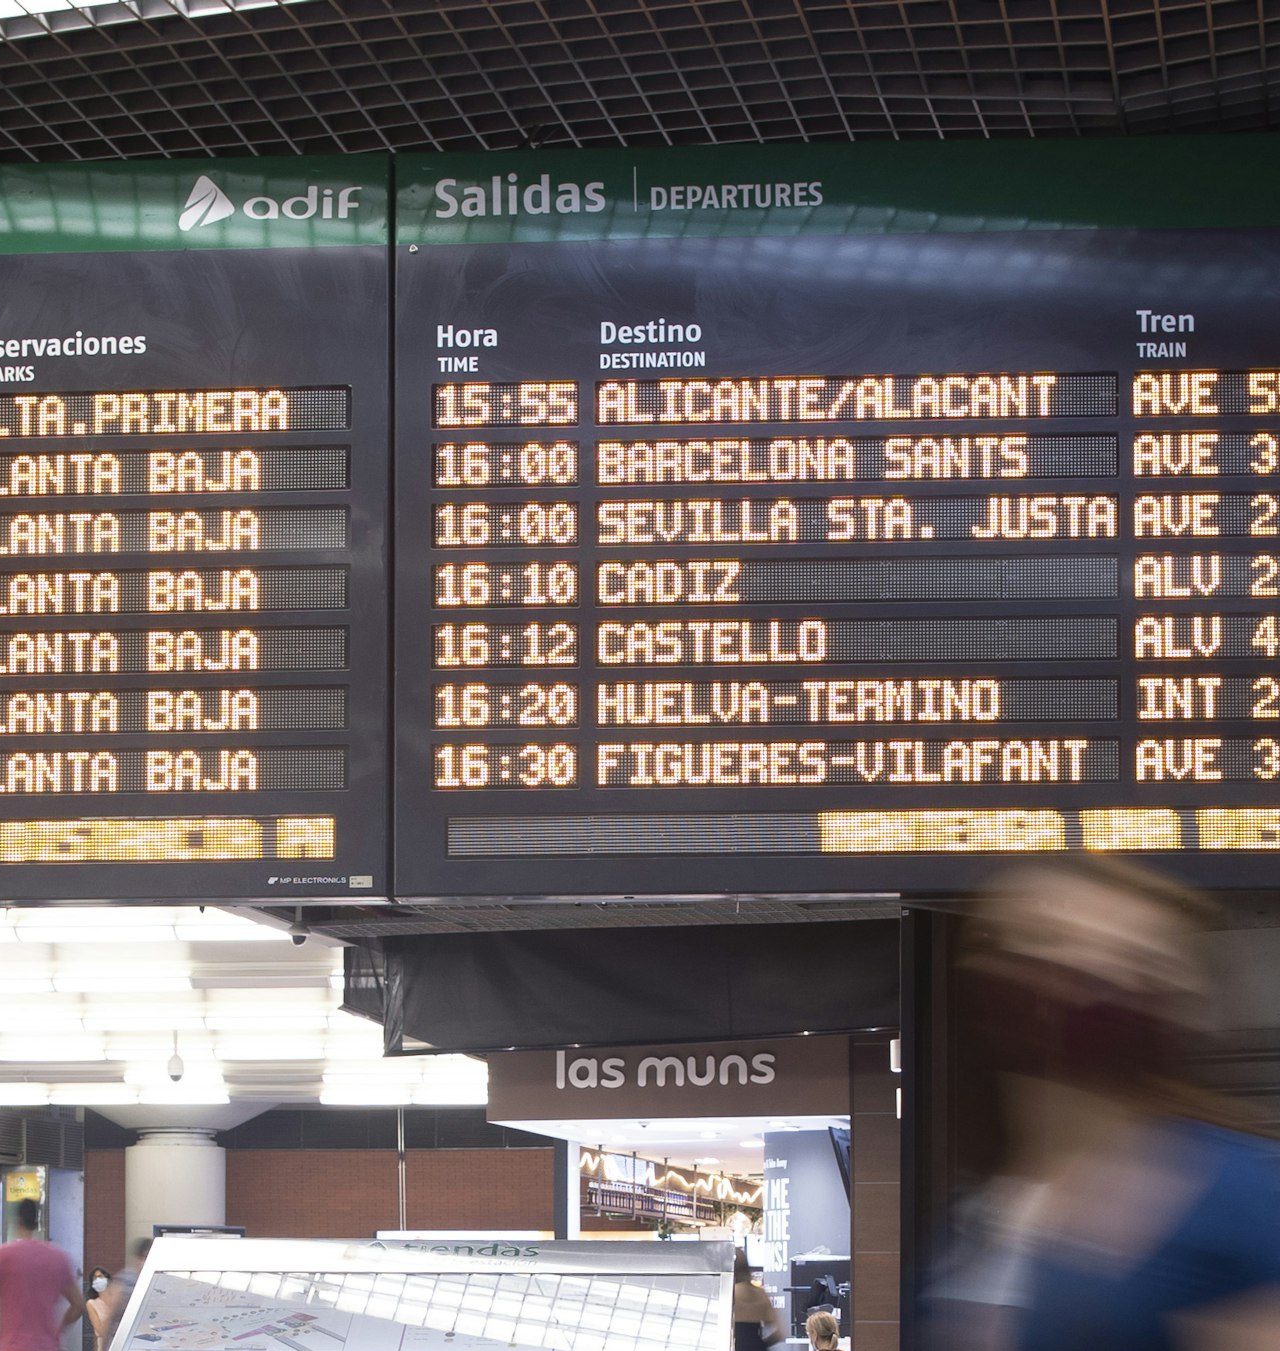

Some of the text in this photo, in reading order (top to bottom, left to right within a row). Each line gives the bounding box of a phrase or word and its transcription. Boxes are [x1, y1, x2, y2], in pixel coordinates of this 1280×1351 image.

[244, 186, 362, 220] adif
[435, 173, 823, 218] Salidas DEPARTURES
[438, 325, 497, 347] Hora
[601, 318, 701, 343] Destino
[1136, 310, 1194, 332] Tren
[438, 357, 478, 372] TIME
[600, 352, 705, 368] DESTINATION
[1137, 343, 1186, 357] TRAIN
[438, 383, 575, 425] 15:55
[598, 375, 1056, 423] ALICANTE/ALACANT
[1133, 373, 1218, 415] AVE
[149, 450, 259, 492] BAJA
[438, 443, 575, 485] 16:00
[598, 439, 854, 483] BARCELONA
[885, 436, 1027, 479] SANTS
[1133, 433, 1219, 475] AVE
[149, 510, 259, 552] BAJA
[438, 503, 575, 545] 16:00
[598, 500, 797, 543] SEVILLA
[827, 498, 933, 540] STA.
[971, 496, 1115, 538] JUSTA
[1134, 494, 1219, 536] AVE
[148, 569, 258, 612] BAJA
[438, 563, 575, 606] 16:10
[598, 561, 740, 603] CADIZ
[1134, 555, 1220, 597] ALV
[147, 629, 258, 671] BAJA
[437, 624, 575, 666] 16:12
[598, 620, 826, 664] CASTELLO
[1135, 616, 1221, 658] ALV
[147, 689, 258, 731] BAJA
[437, 684, 575, 726] 16:20
[597, 679, 999, 724] HUELVA-TERMINO
[1139, 677, 1221, 719] INT
[146, 750, 257, 791] BAJA
[437, 744, 574, 787] 16:30
[598, 740, 1087, 785] FIGUERES-VILAFANT
[1136, 738, 1222, 780] AVE
[556, 1050, 776, 1089] las muns
